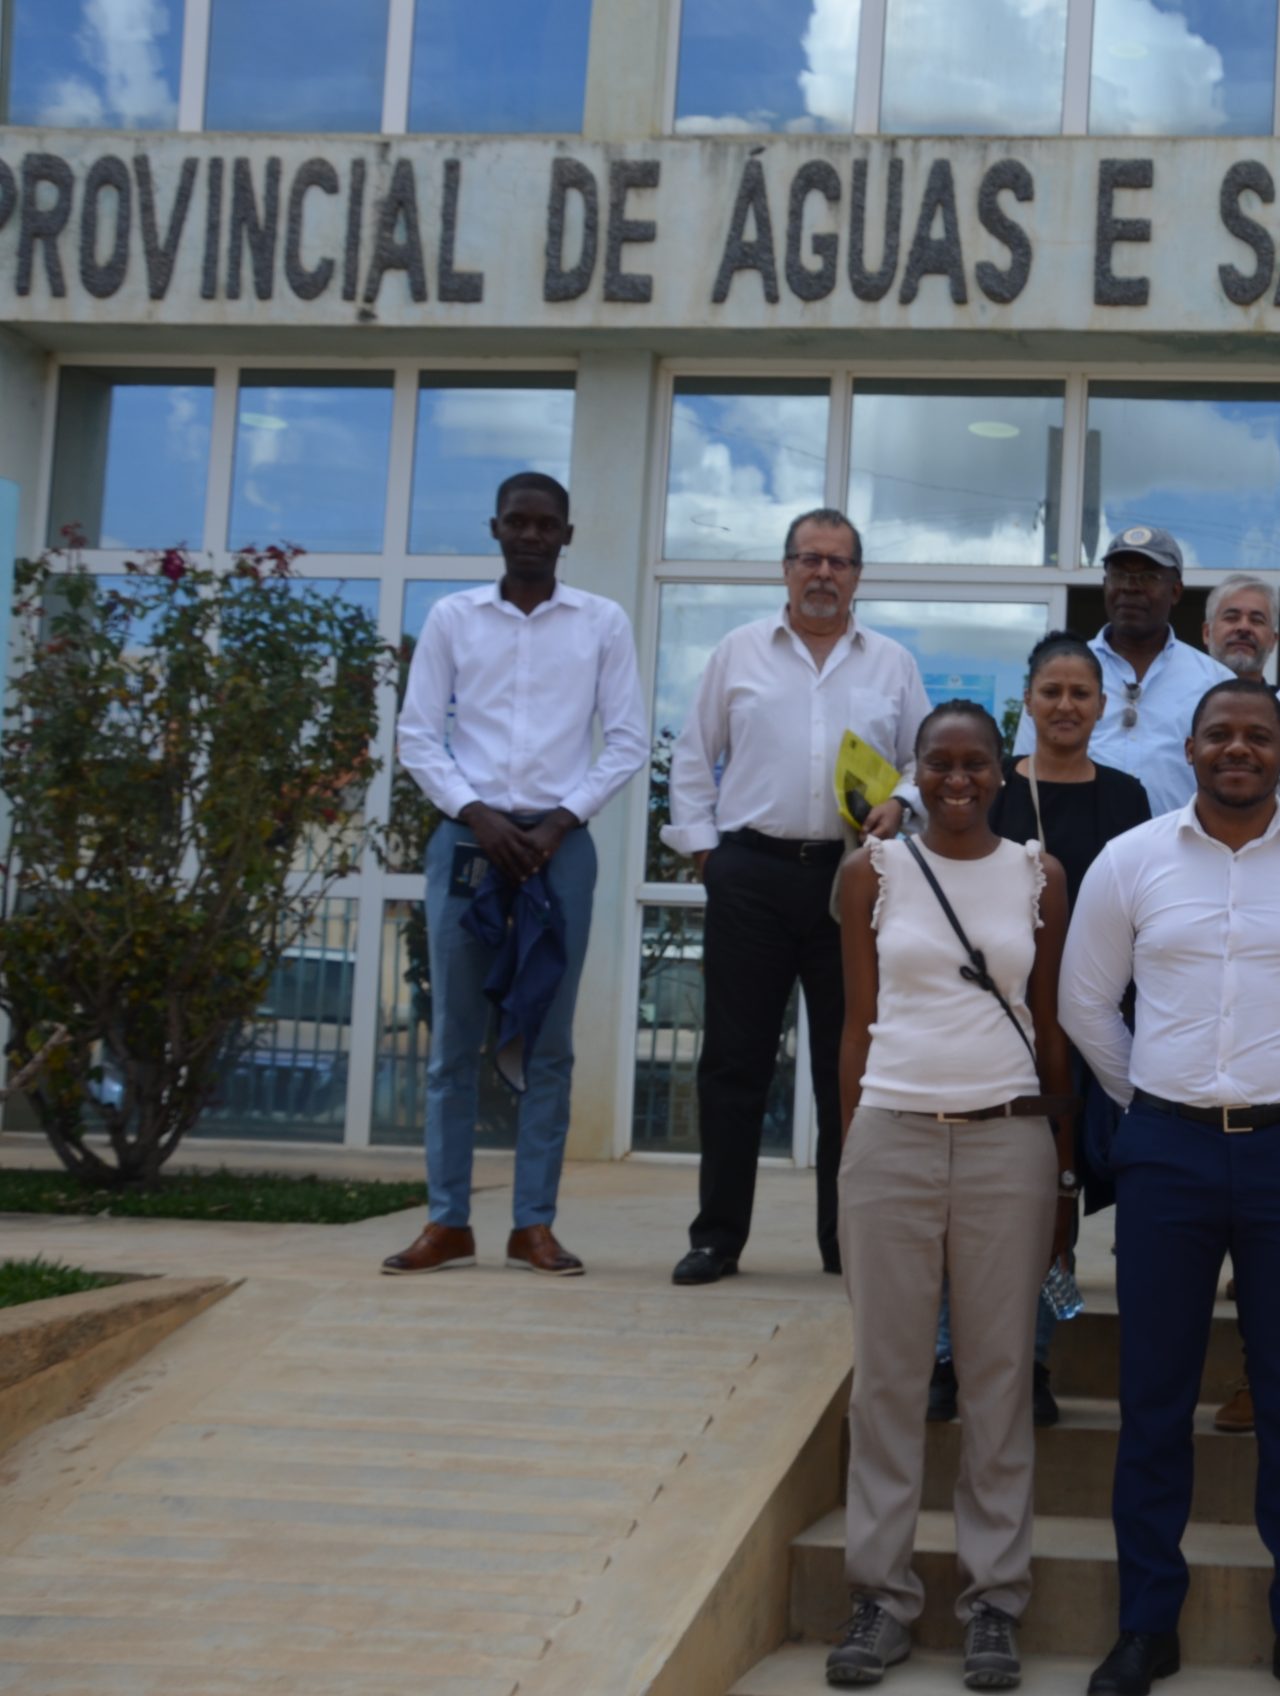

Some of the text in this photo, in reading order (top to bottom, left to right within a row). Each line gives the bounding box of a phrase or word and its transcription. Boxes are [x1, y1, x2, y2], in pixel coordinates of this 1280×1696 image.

[0, 153, 484, 303] ROVINCIAL
[543, 157, 661, 303] DE
[711, 146, 1035, 305] ÁGUAS
[1093, 158, 1154, 306] E
